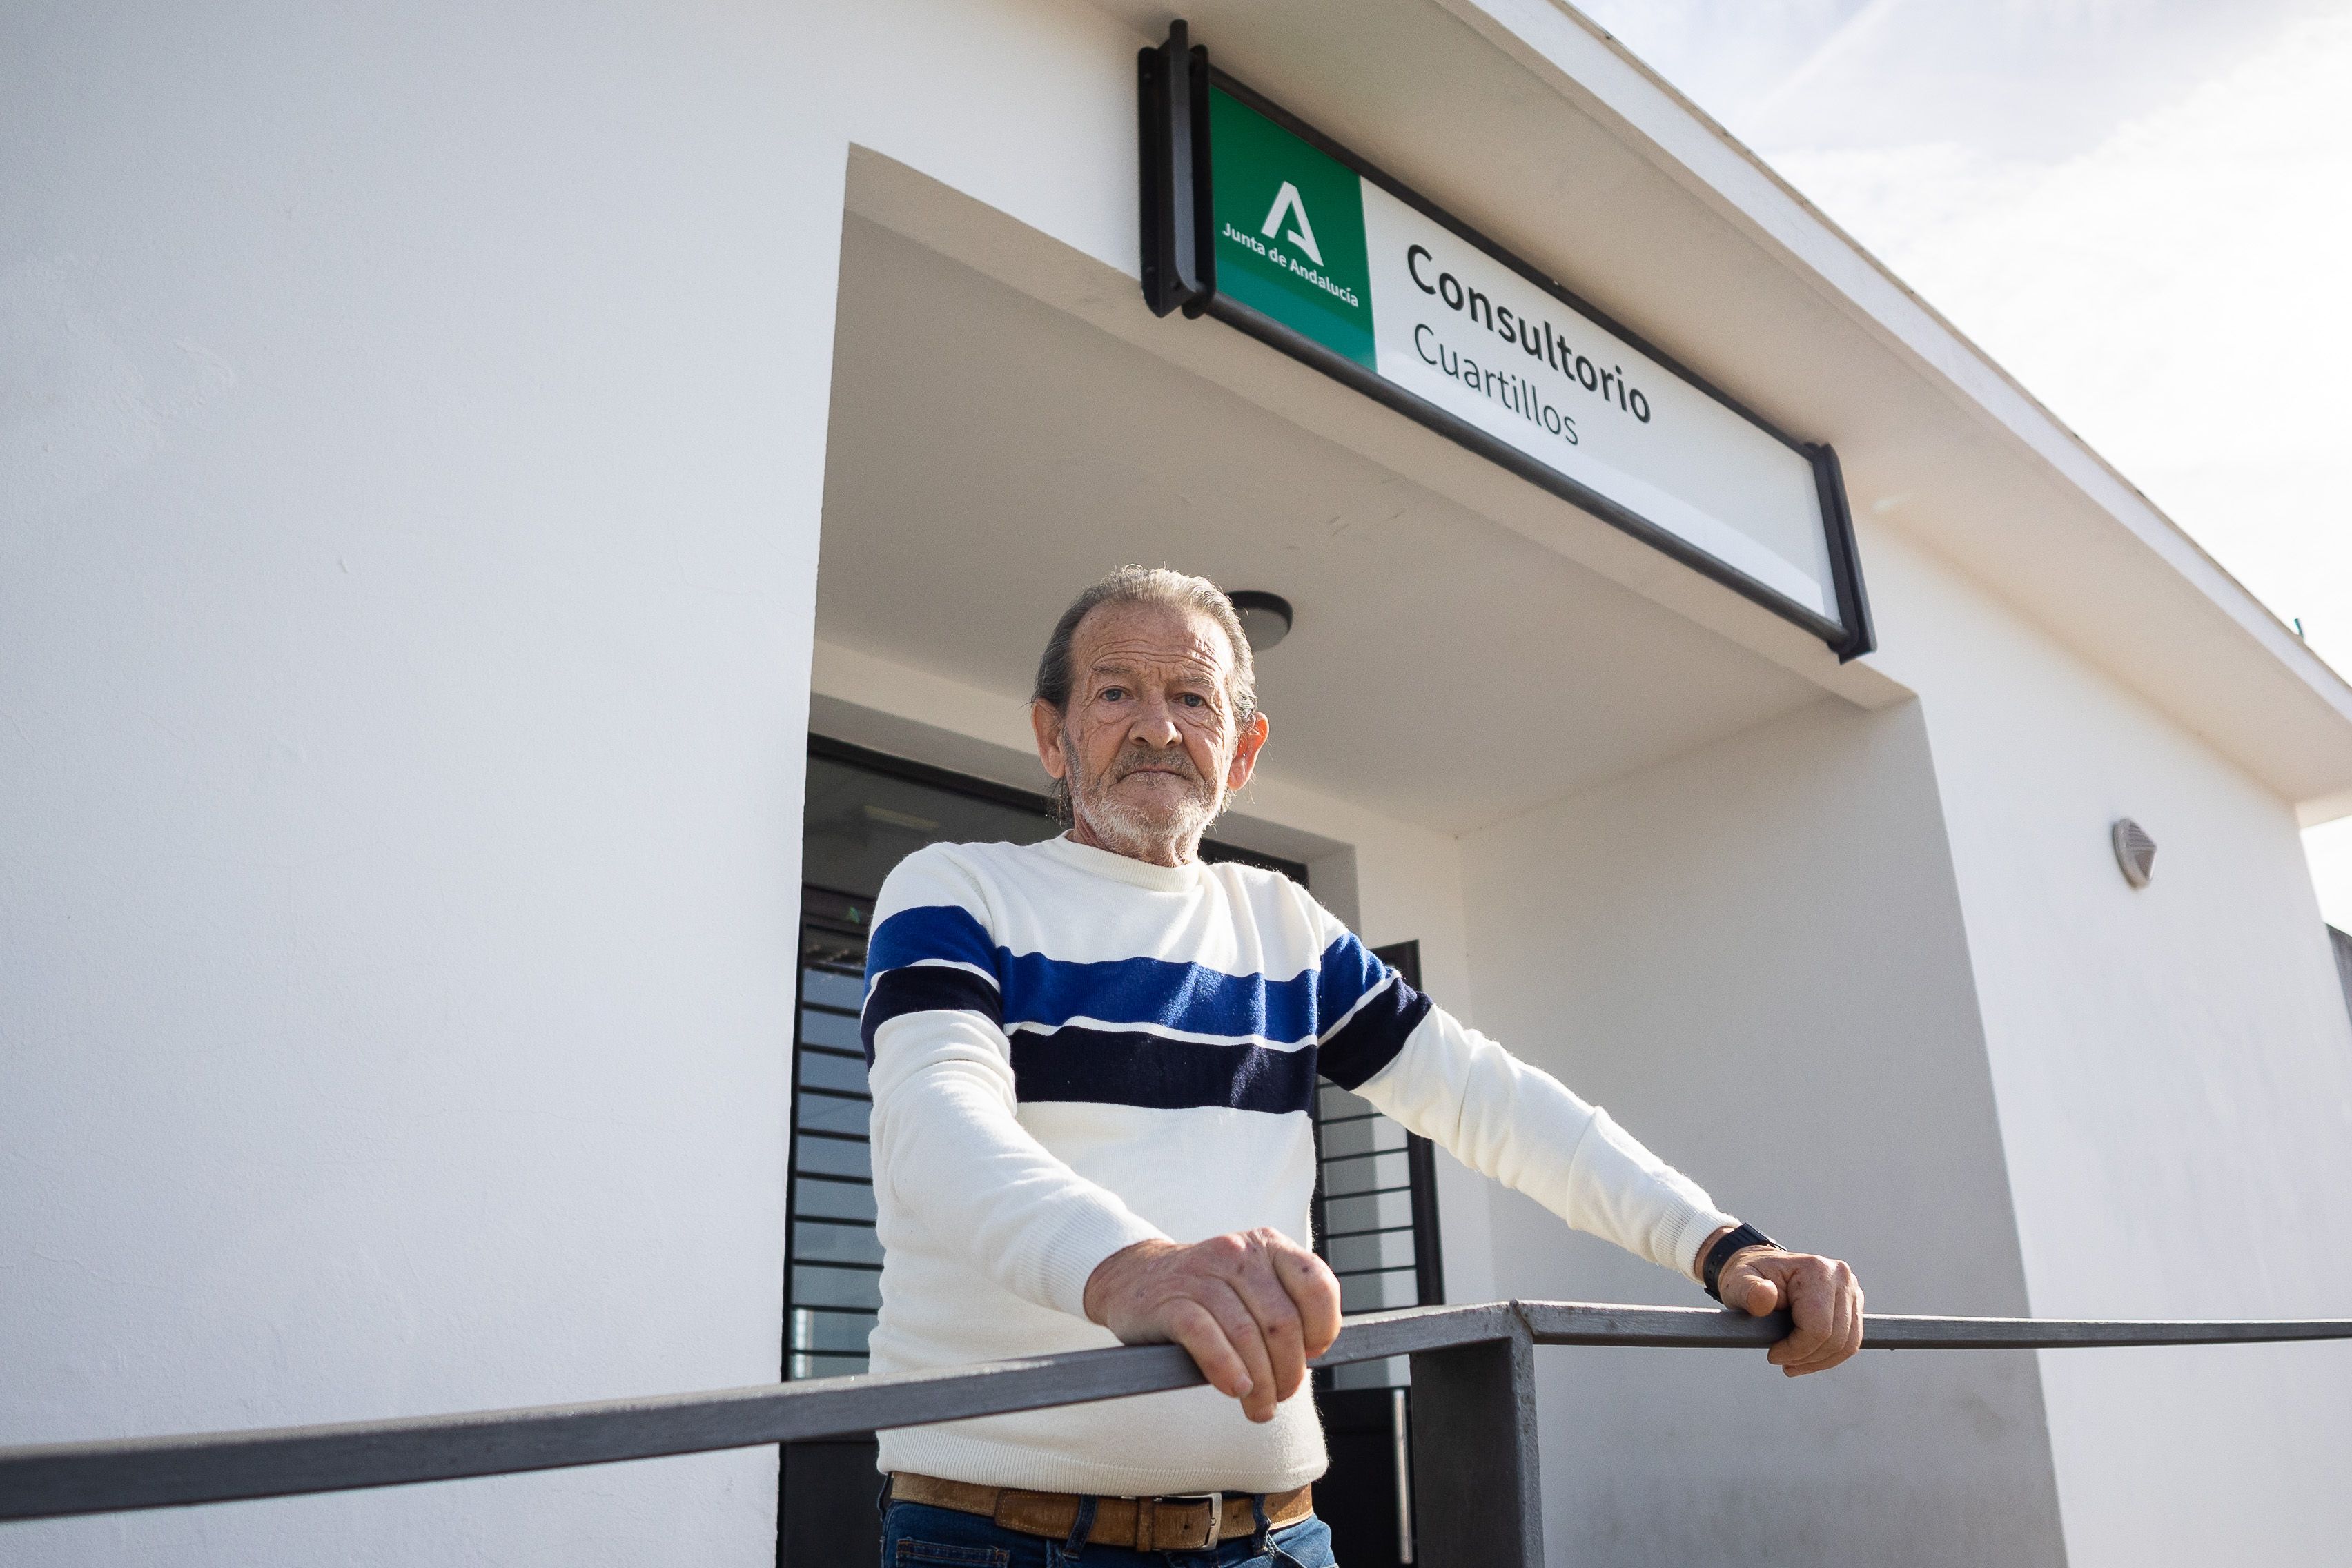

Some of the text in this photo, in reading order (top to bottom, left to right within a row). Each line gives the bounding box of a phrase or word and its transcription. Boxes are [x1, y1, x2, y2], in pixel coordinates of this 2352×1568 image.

[1222, 222, 1359, 308] Junta de Andalucía
[1407, 244, 1651, 424] Consultorio
[1413, 323, 1579, 446] Cuartillos
